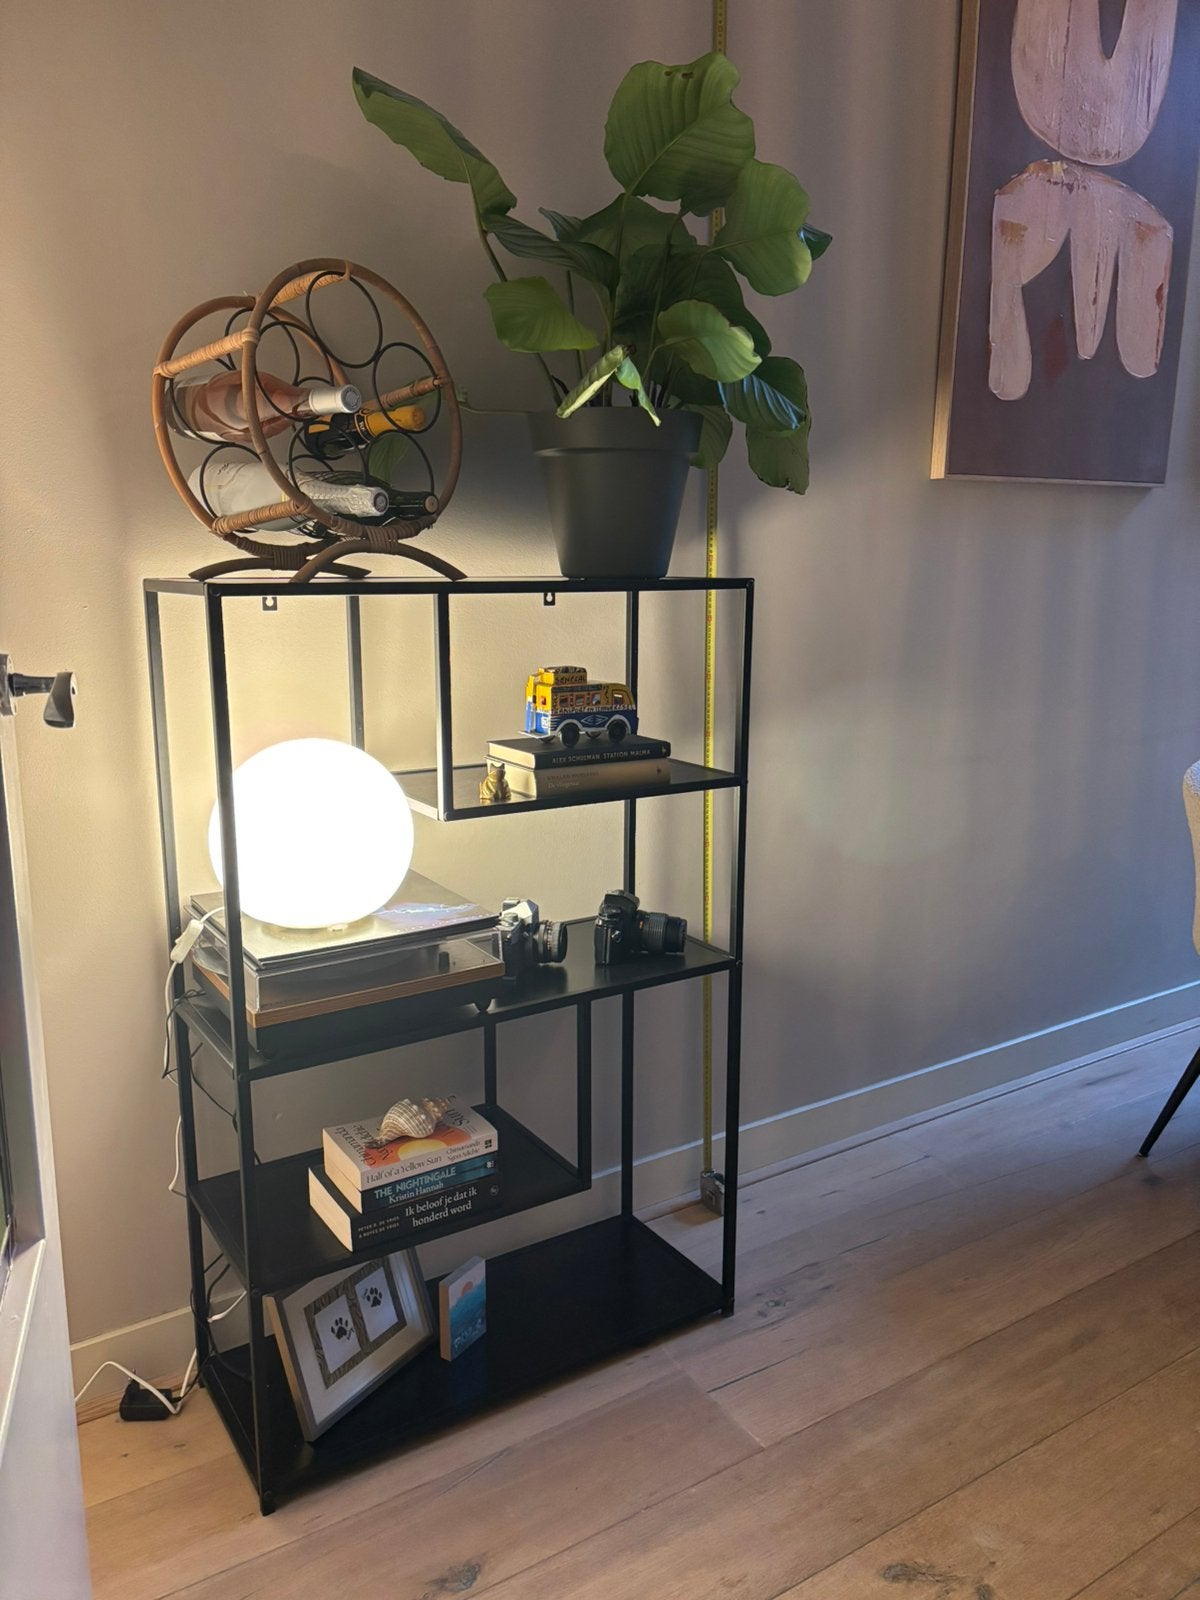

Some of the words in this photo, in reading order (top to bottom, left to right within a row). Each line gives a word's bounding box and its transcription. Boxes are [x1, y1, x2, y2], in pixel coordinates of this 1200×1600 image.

[603, 751, 628, 759] STATION
[367, 1170, 384, 1183] Half
[401, 1159, 425, 1174] Yellow
[426, 1155, 442, 1167] Sun
[374, 1188, 393, 1199] THE
[396, 1167, 456, 1192] NIGHTINGALE
[389, 1190, 414, 1204] Kristin
[416, 1182, 443, 1197] Hannah
[405, 1204, 414, 1216] Ik
[416, 1197, 443, 1212] beloof
[453, 1190, 467, 1201] dat
[468, 1187, 477, 1197] ik
[413, 1209, 449, 1227] honderd
[450, 1201, 472, 1216] word
